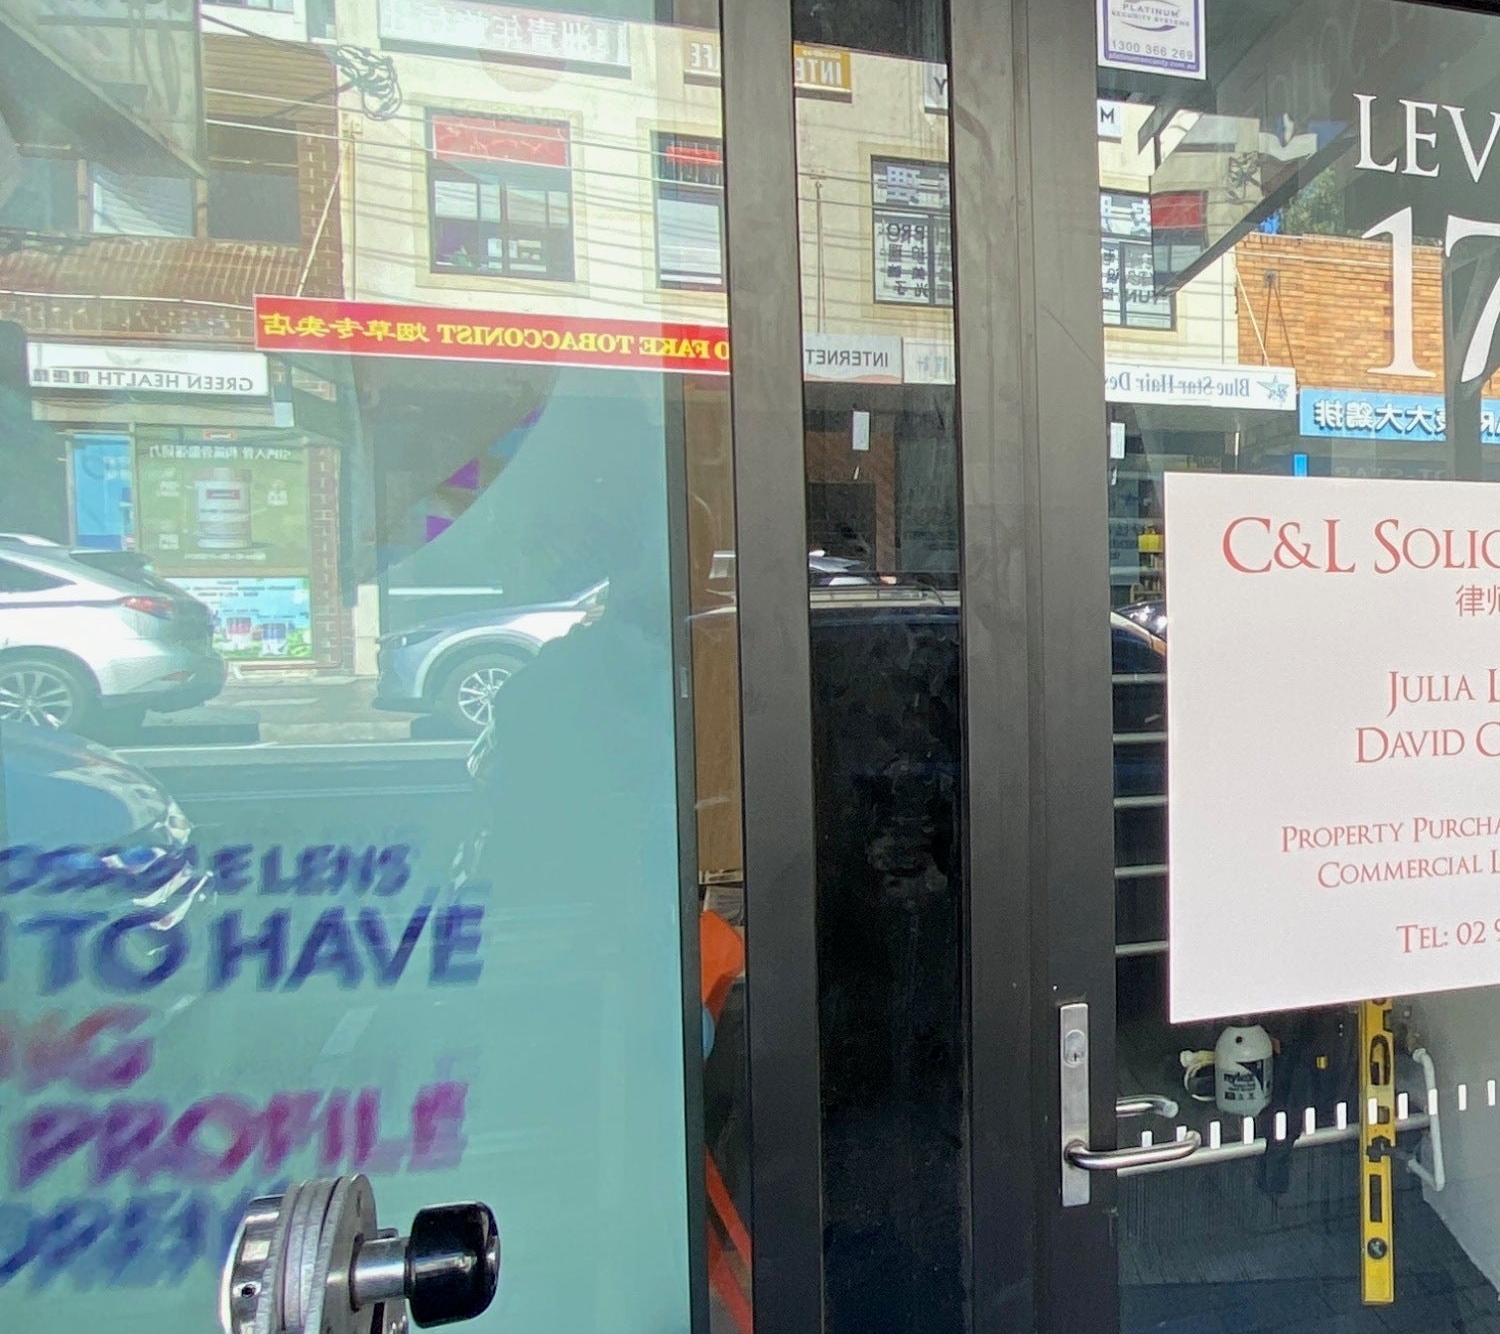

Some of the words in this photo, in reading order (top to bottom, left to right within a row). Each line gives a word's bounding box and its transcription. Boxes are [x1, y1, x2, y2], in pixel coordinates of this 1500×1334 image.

[1123, 3, 1179, 18] PLATINUM
[1112, 40, 1140, 53] 1300
[1222, 516, 1356, 575] C&L
[1386, 669, 1475, 717] JULIA
[1355, 726, 1465, 764] DAVID
[1281, 821, 1404, 853] PROPERTY
[1317, 853, 1484, 889] COMMERCIAL
[205, 904, 487, 994] HAVE
[1396, 922, 1449, 954] TEL:
[1455, 921, 1486, 946] 02
